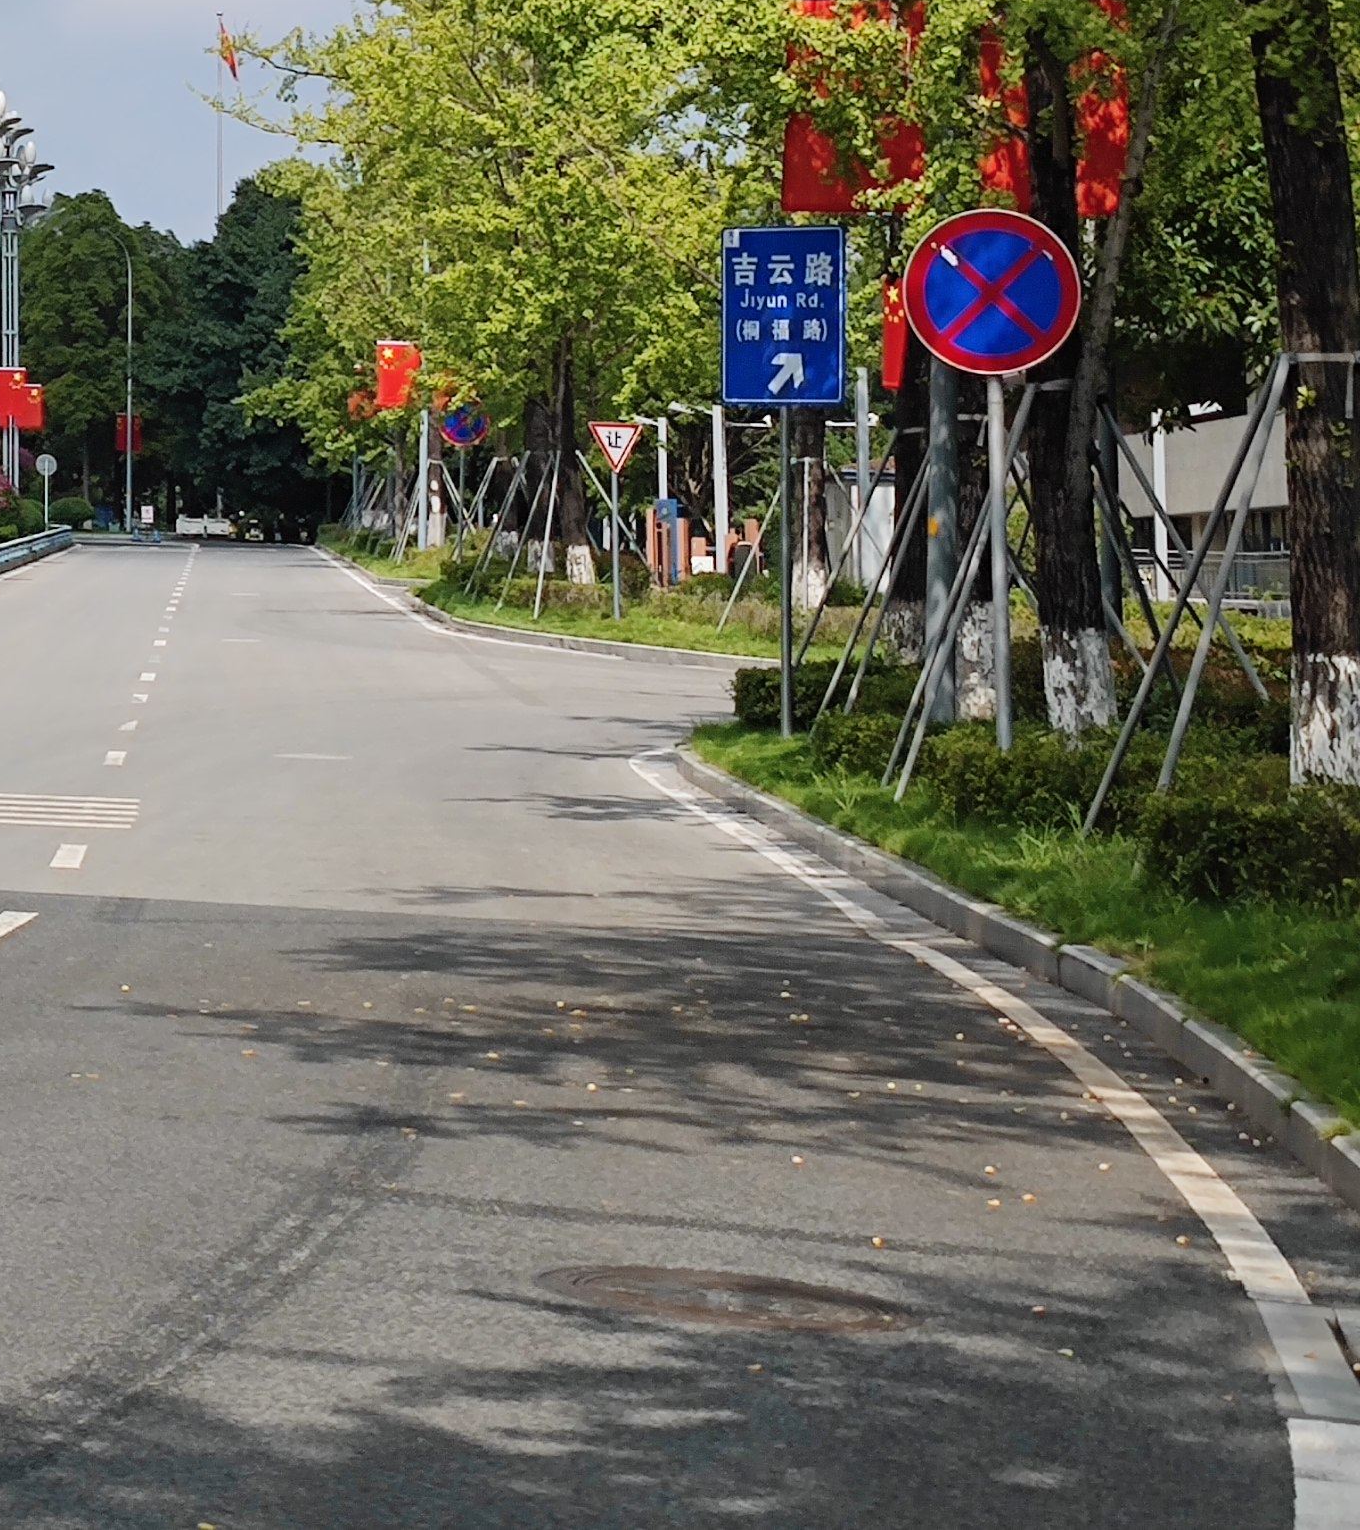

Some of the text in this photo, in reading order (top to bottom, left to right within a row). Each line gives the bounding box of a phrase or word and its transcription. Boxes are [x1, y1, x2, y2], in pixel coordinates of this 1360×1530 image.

[732, 252, 833, 285] 吉云路
[740, 288, 825, 310] Jiyun Rd.
[605, 431, 622, 449] 让
